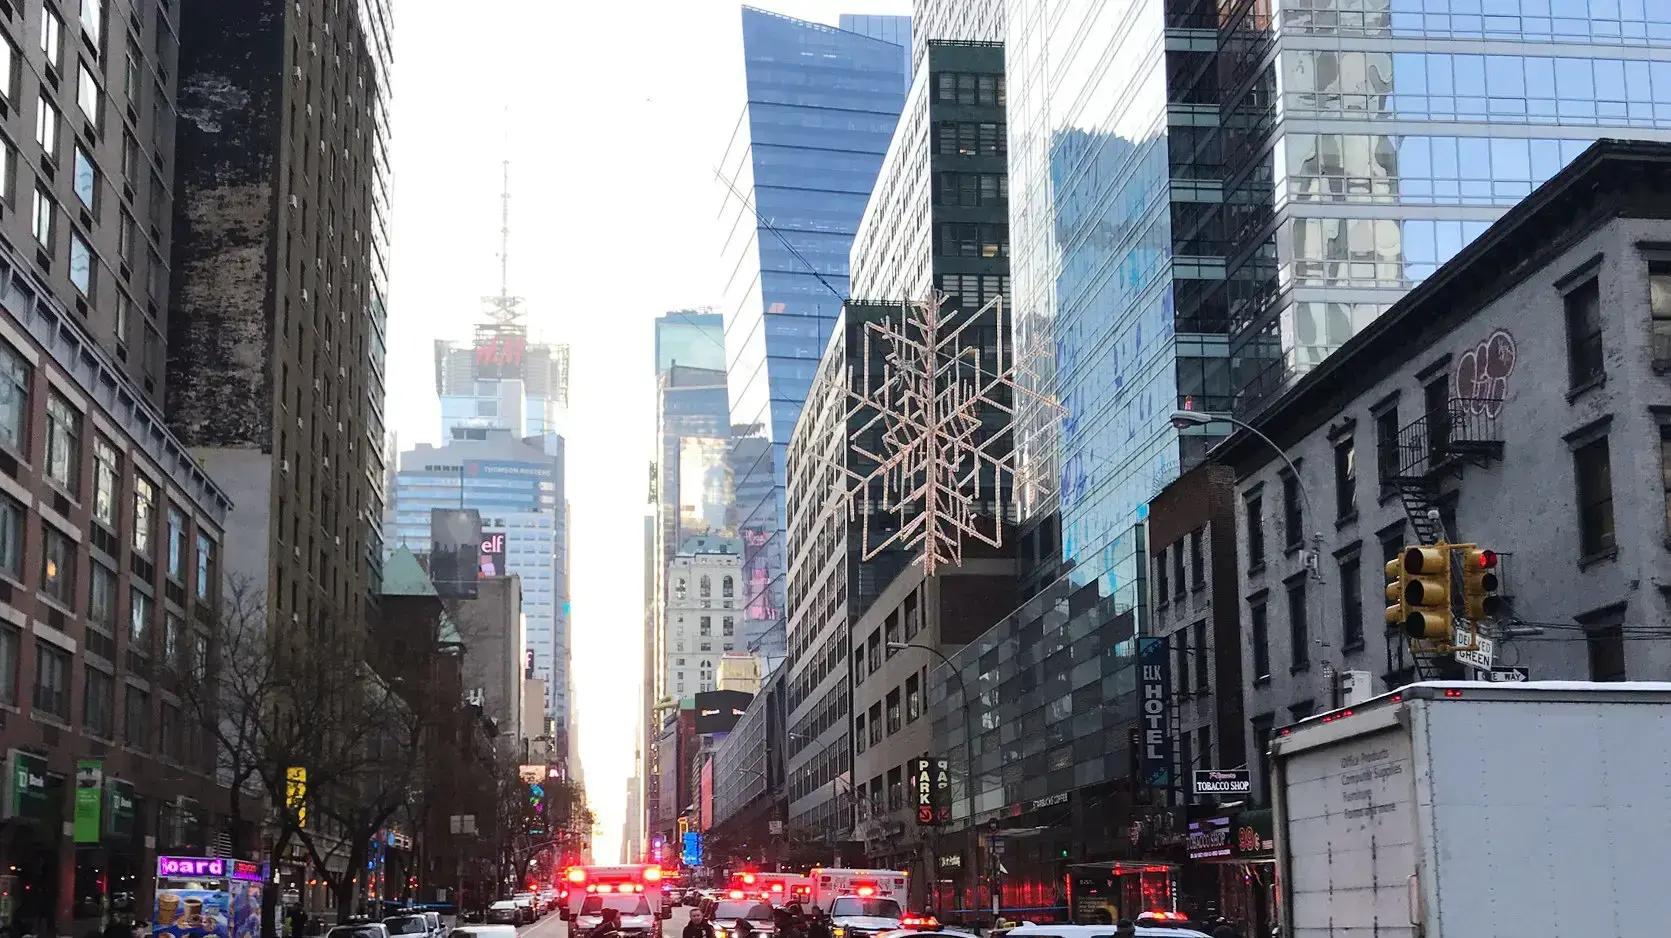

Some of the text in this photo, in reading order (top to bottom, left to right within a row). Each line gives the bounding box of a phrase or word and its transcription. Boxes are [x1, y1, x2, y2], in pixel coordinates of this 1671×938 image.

[484, 465, 552, 477] THOMSON REUTERS
[1458, 633, 1491, 654] DELYED
[1460, 649, 1490, 667] GREEN
[1143, 665, 1162, 681] ELK
[1482, 672, 1521, 681] OE WAY
[1144, 684, 1164, 759] HOTEL
[919, 760, 931, 805] PARK
[1197, 780, 1250, 791] TOBACCO SHOP
